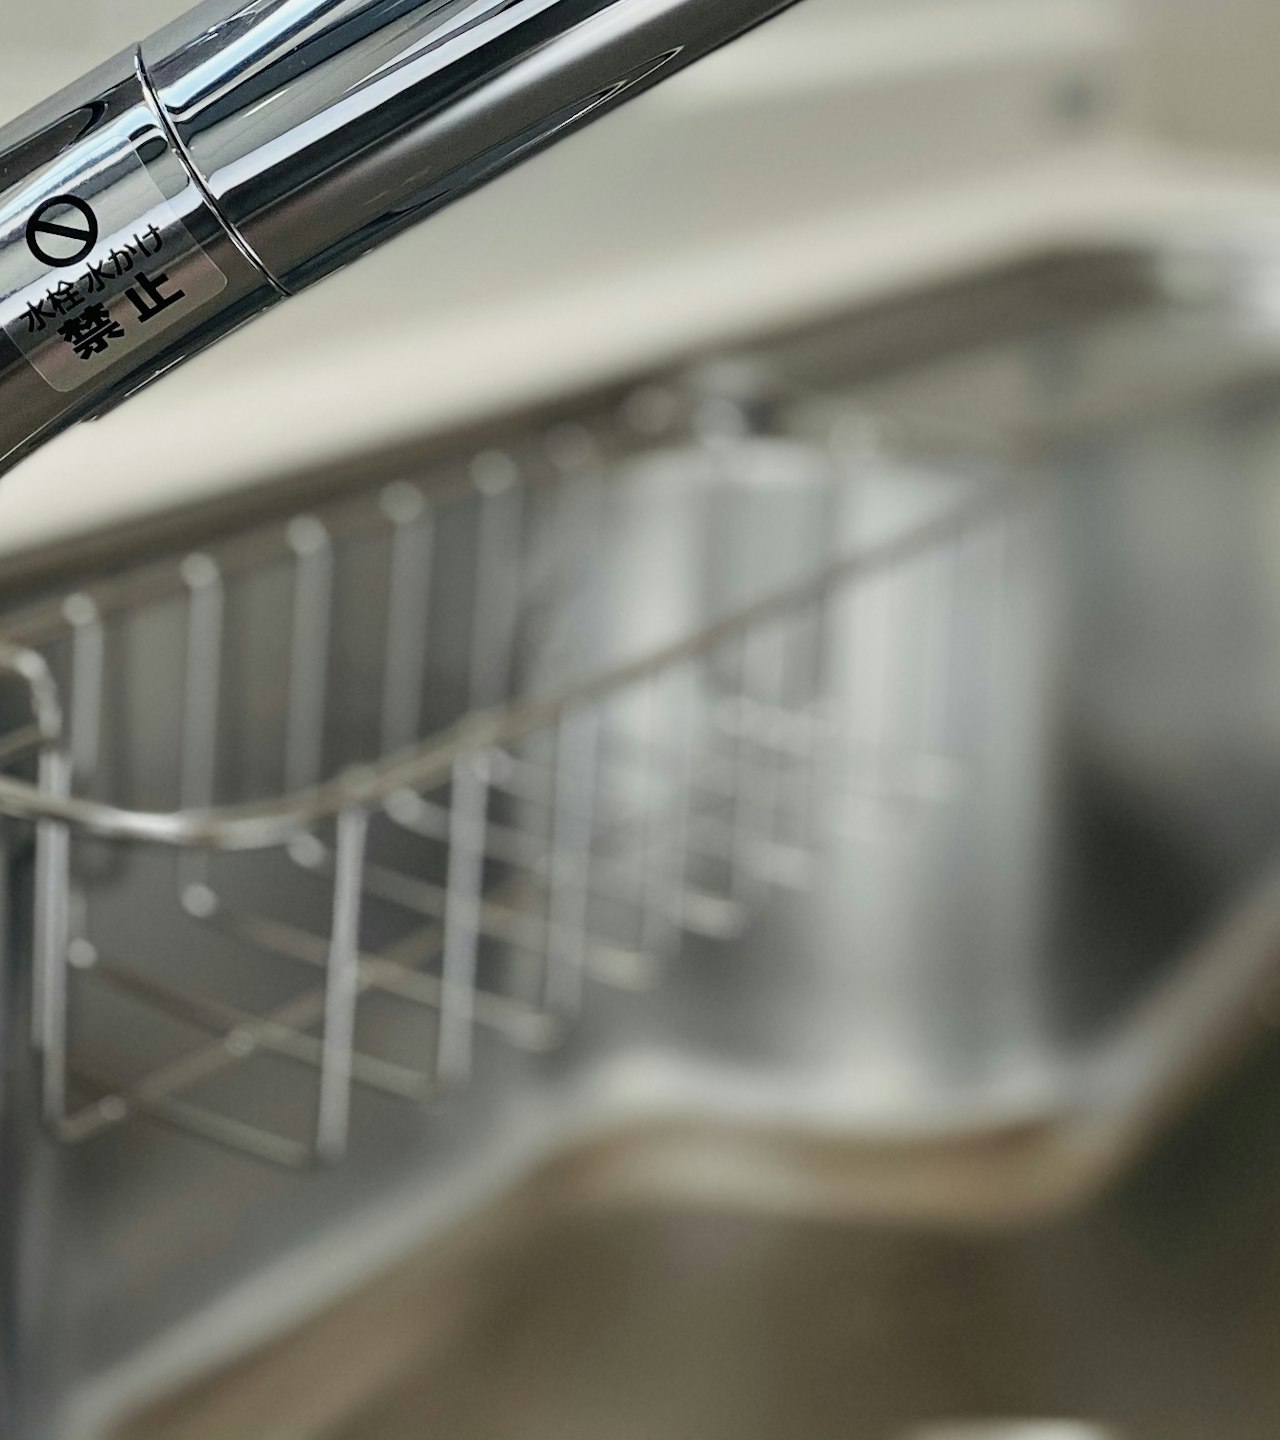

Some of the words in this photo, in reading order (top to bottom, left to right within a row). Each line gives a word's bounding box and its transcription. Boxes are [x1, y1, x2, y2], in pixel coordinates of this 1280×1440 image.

[19, 224, 163, 333] 水栓水かけ
[57, 271, 186, 360] 禁止
